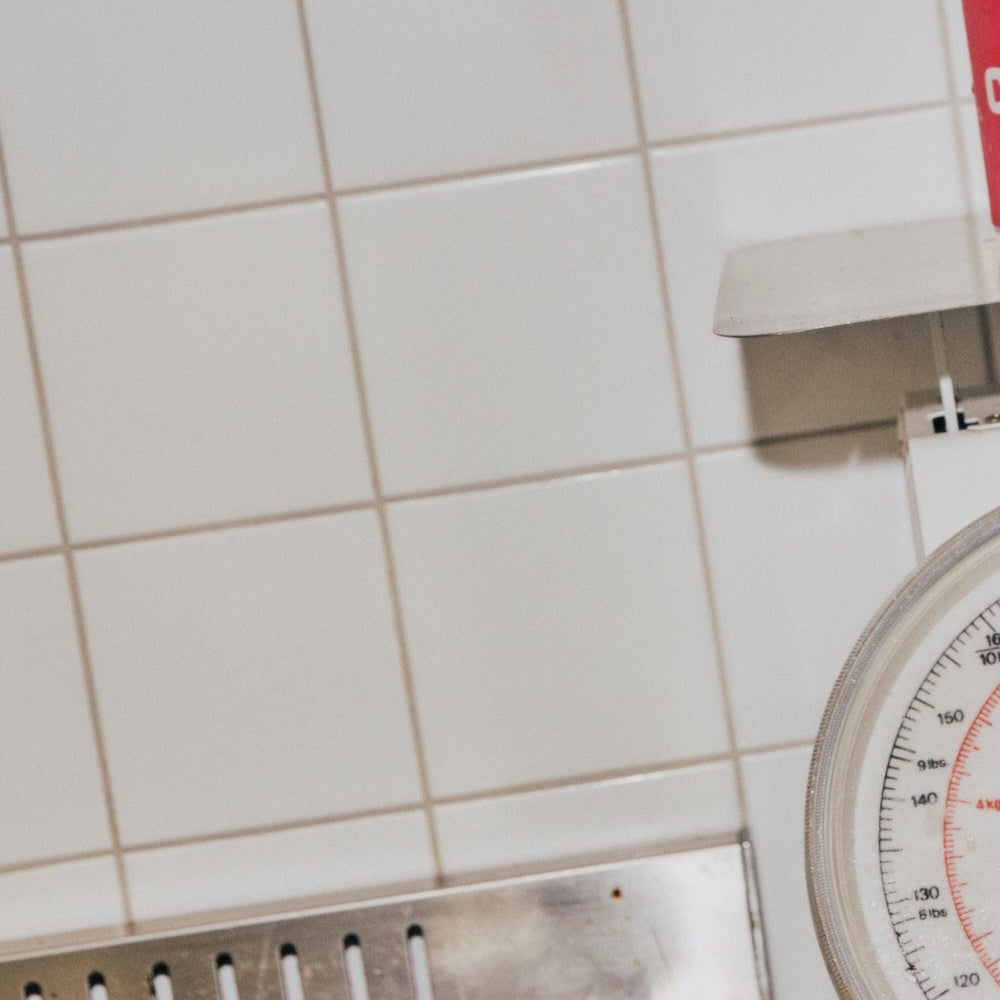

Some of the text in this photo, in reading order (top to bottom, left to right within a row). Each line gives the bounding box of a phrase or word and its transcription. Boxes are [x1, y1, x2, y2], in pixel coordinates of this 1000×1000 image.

[937, 709, 965, 725] 150
[911, 791, 938, 808] 140
[913, 886, 940, 901] 130
[953, 972, 980, 988] 120
